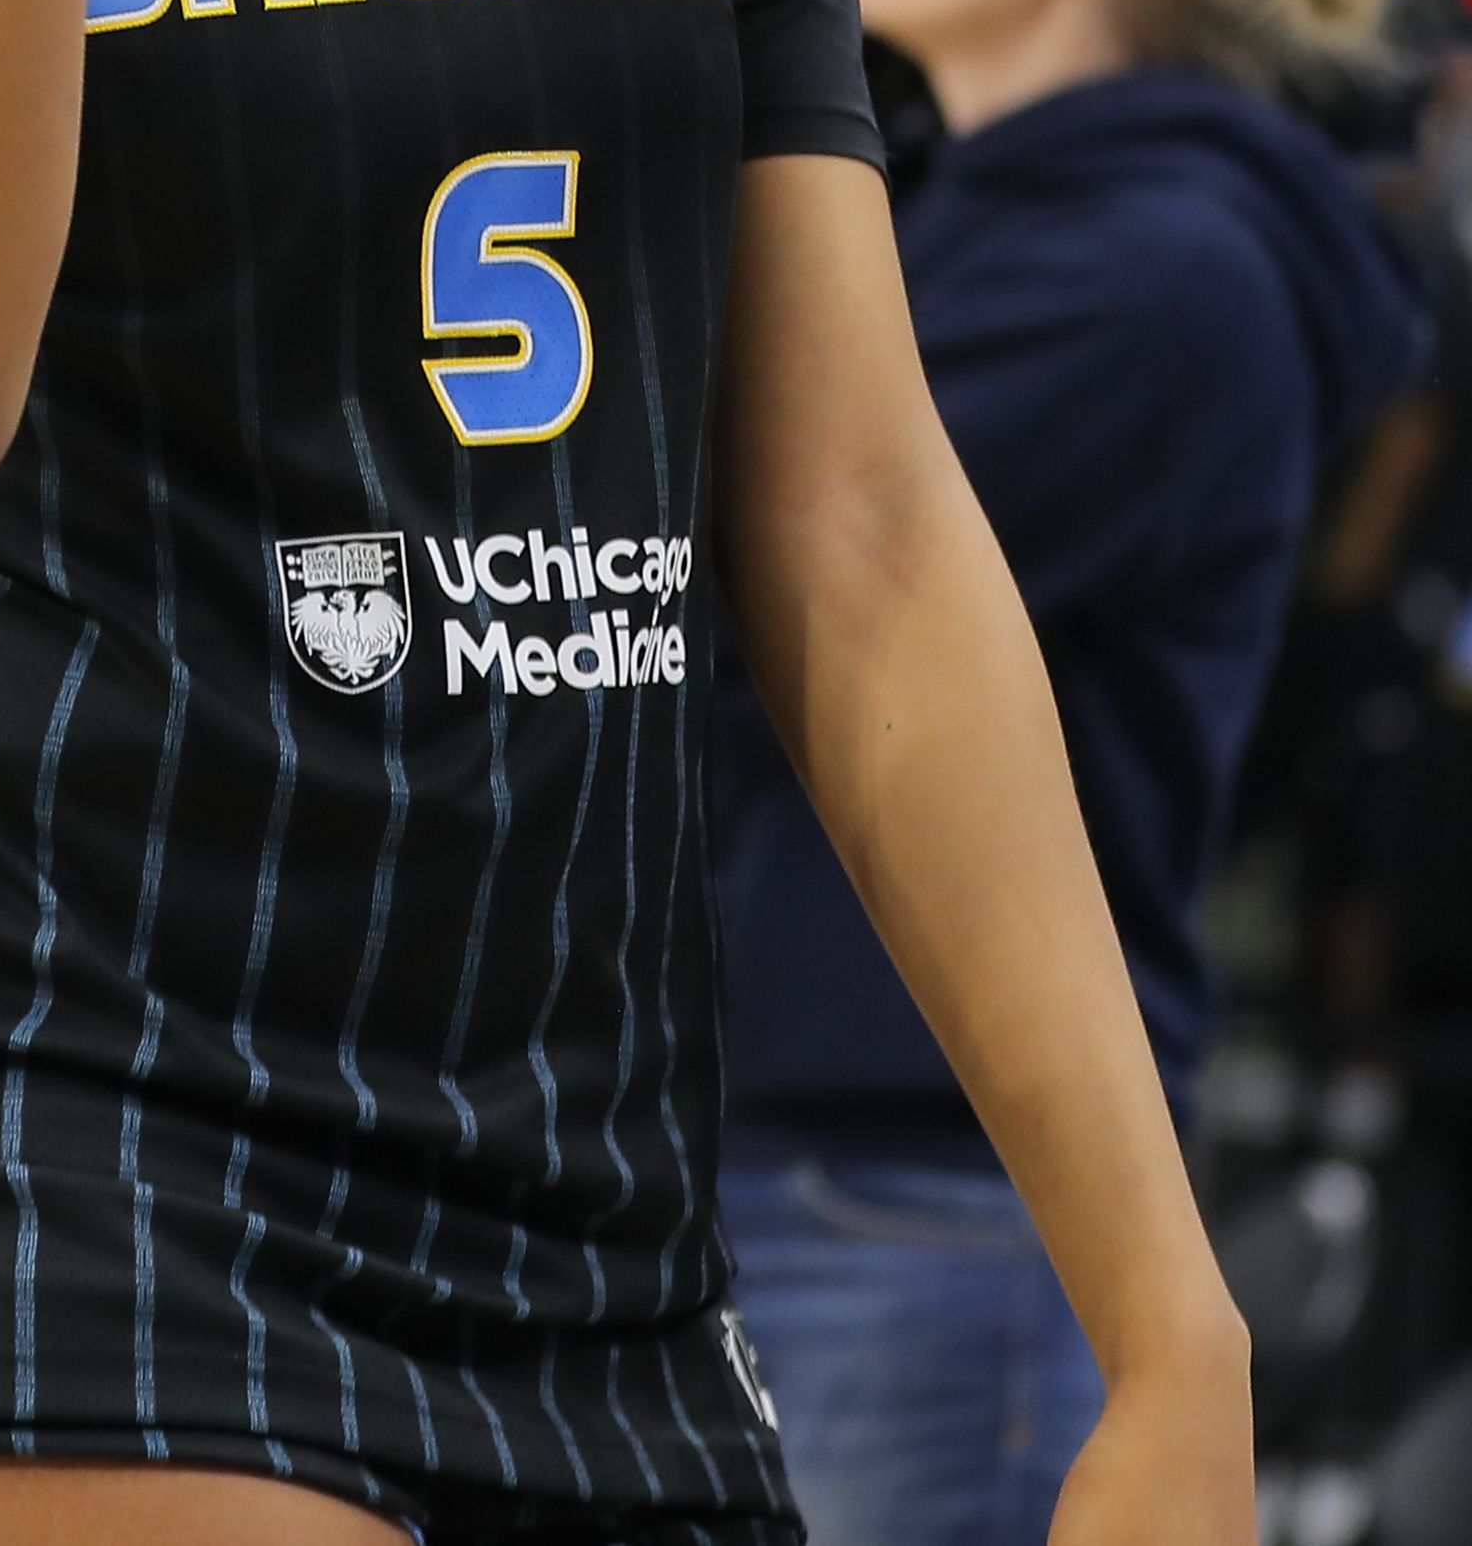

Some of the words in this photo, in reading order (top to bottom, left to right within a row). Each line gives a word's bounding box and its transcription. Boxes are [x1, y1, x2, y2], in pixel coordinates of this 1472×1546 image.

[421, 150, 595, 447] 5
[424, 526, 692, 606] UChicago
[443, 608, 687, 696] Medicine
